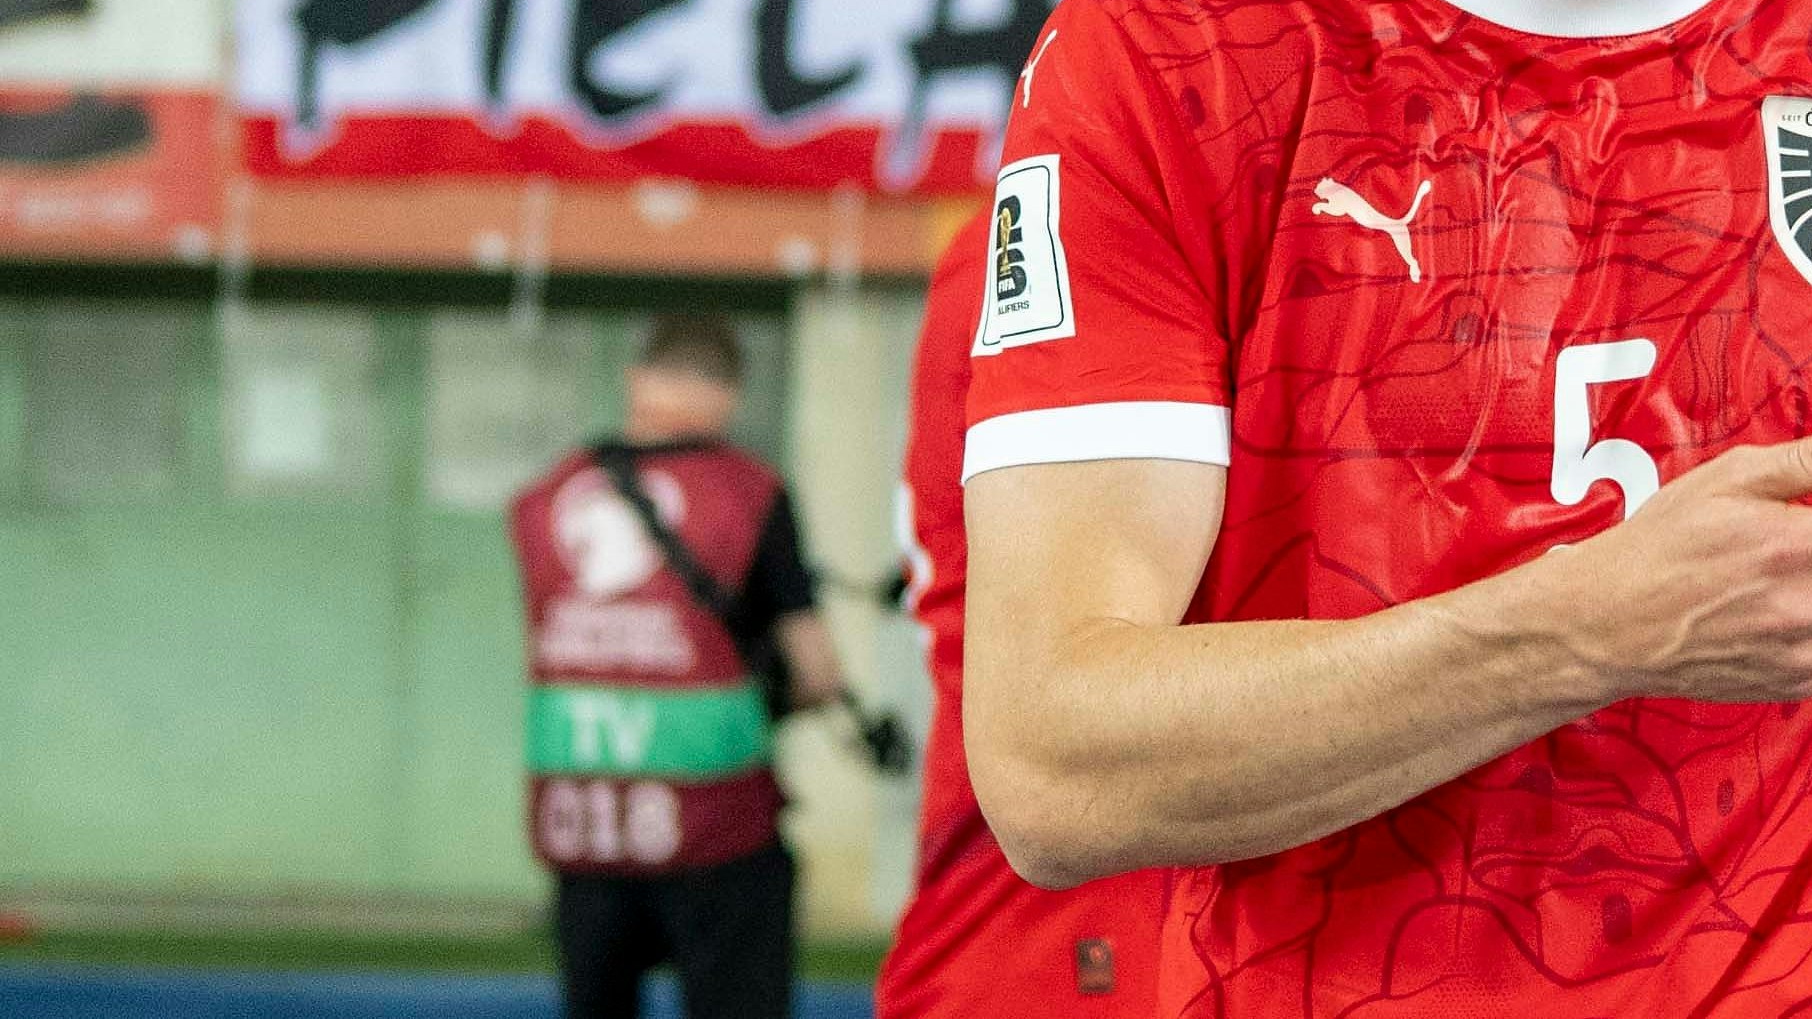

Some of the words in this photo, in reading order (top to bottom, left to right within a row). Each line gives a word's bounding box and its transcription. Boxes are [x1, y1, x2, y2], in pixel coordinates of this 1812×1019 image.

[1782, 114, 1801, 122] SEIT
[1551, 338, 1660, 521] 5
[571, 690, 657, 769] TV
